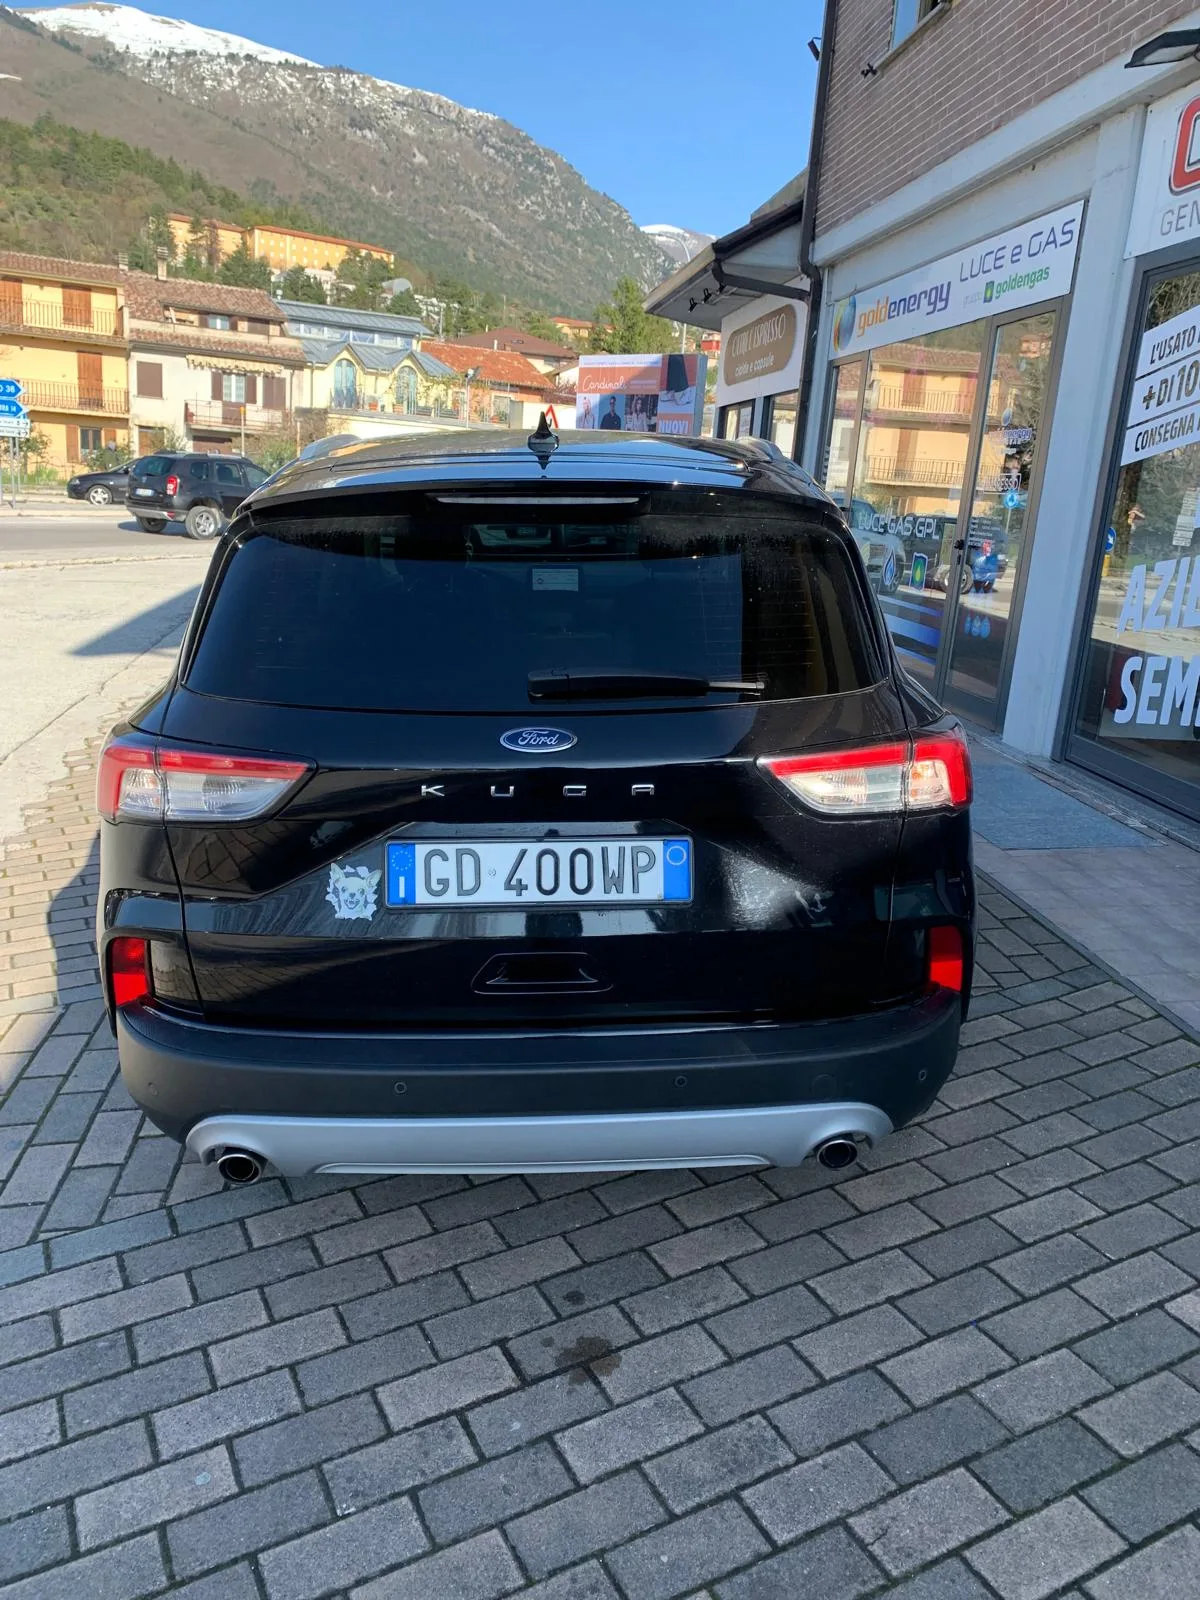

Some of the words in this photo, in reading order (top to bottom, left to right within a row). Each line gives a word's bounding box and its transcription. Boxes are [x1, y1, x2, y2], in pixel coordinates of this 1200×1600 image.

[960, 245, 1007, 282] LUCE
[1010, 244, 1023, 264] e
[1027, 218, 1076, 258] GAS
[994, 266, 1050, 299] goldengas
[856, 281, 952, 338] goldenergy
[1150, 325, 1196, 365] L'USATO
[1134, 412, 1195, 452] CONSEGNA
[858, 512, 885, 533] LUCE
[887, 515, 913, 537] GAS
[915, 518, 940, 540] GPL
[1114, 655, 1200, 727] SEM
[518, 730, 560, 745] Ford
[421, 784, 655, 797] KUGA
[424, 847, 481, 897] GD
[503, 846, 657, 897] 400WP
